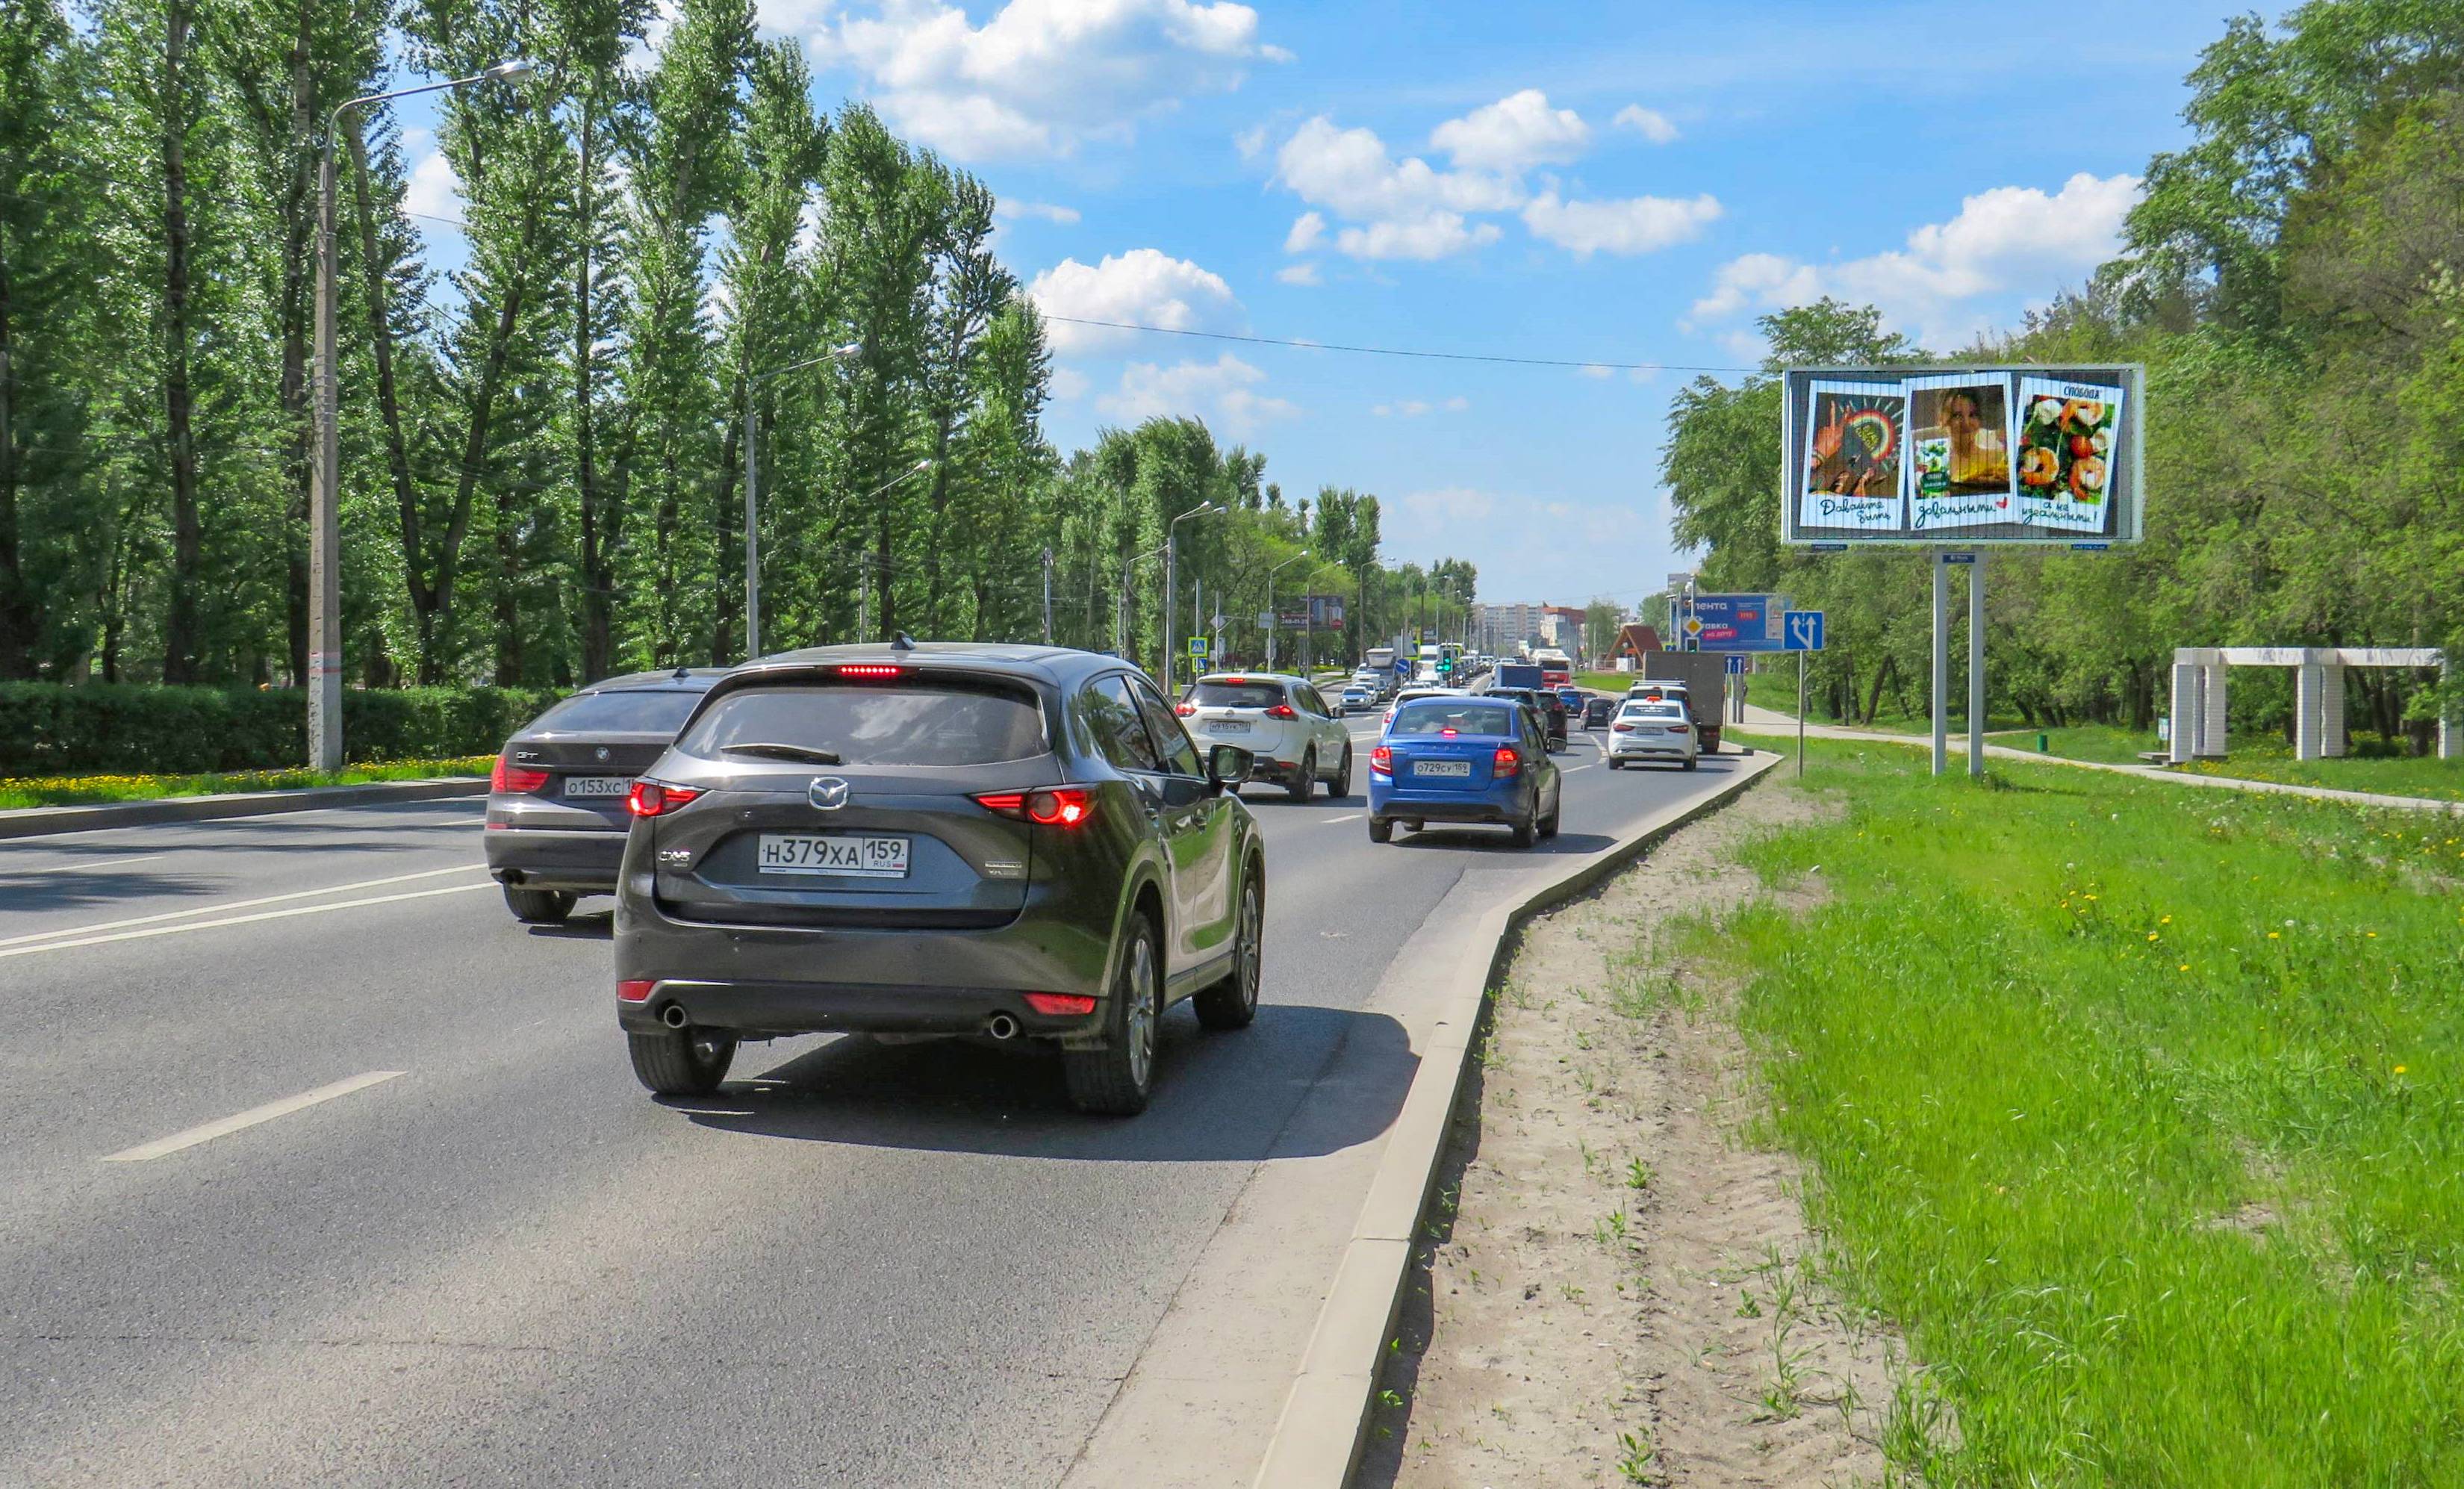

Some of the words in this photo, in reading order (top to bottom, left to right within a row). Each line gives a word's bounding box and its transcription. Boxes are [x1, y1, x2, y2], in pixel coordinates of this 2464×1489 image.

[2063, 385, 2100, 400] СЛОБОДА
[1820, 498, 1885, 516] Давайте
[1856, 510, 1891, 524] быть
[516, 751, 538, 759] GT
[766, 839, 859, 865] Н379ХА
[865, 840, 902, 860] 159
[873, 859, 892, 868] RUS
